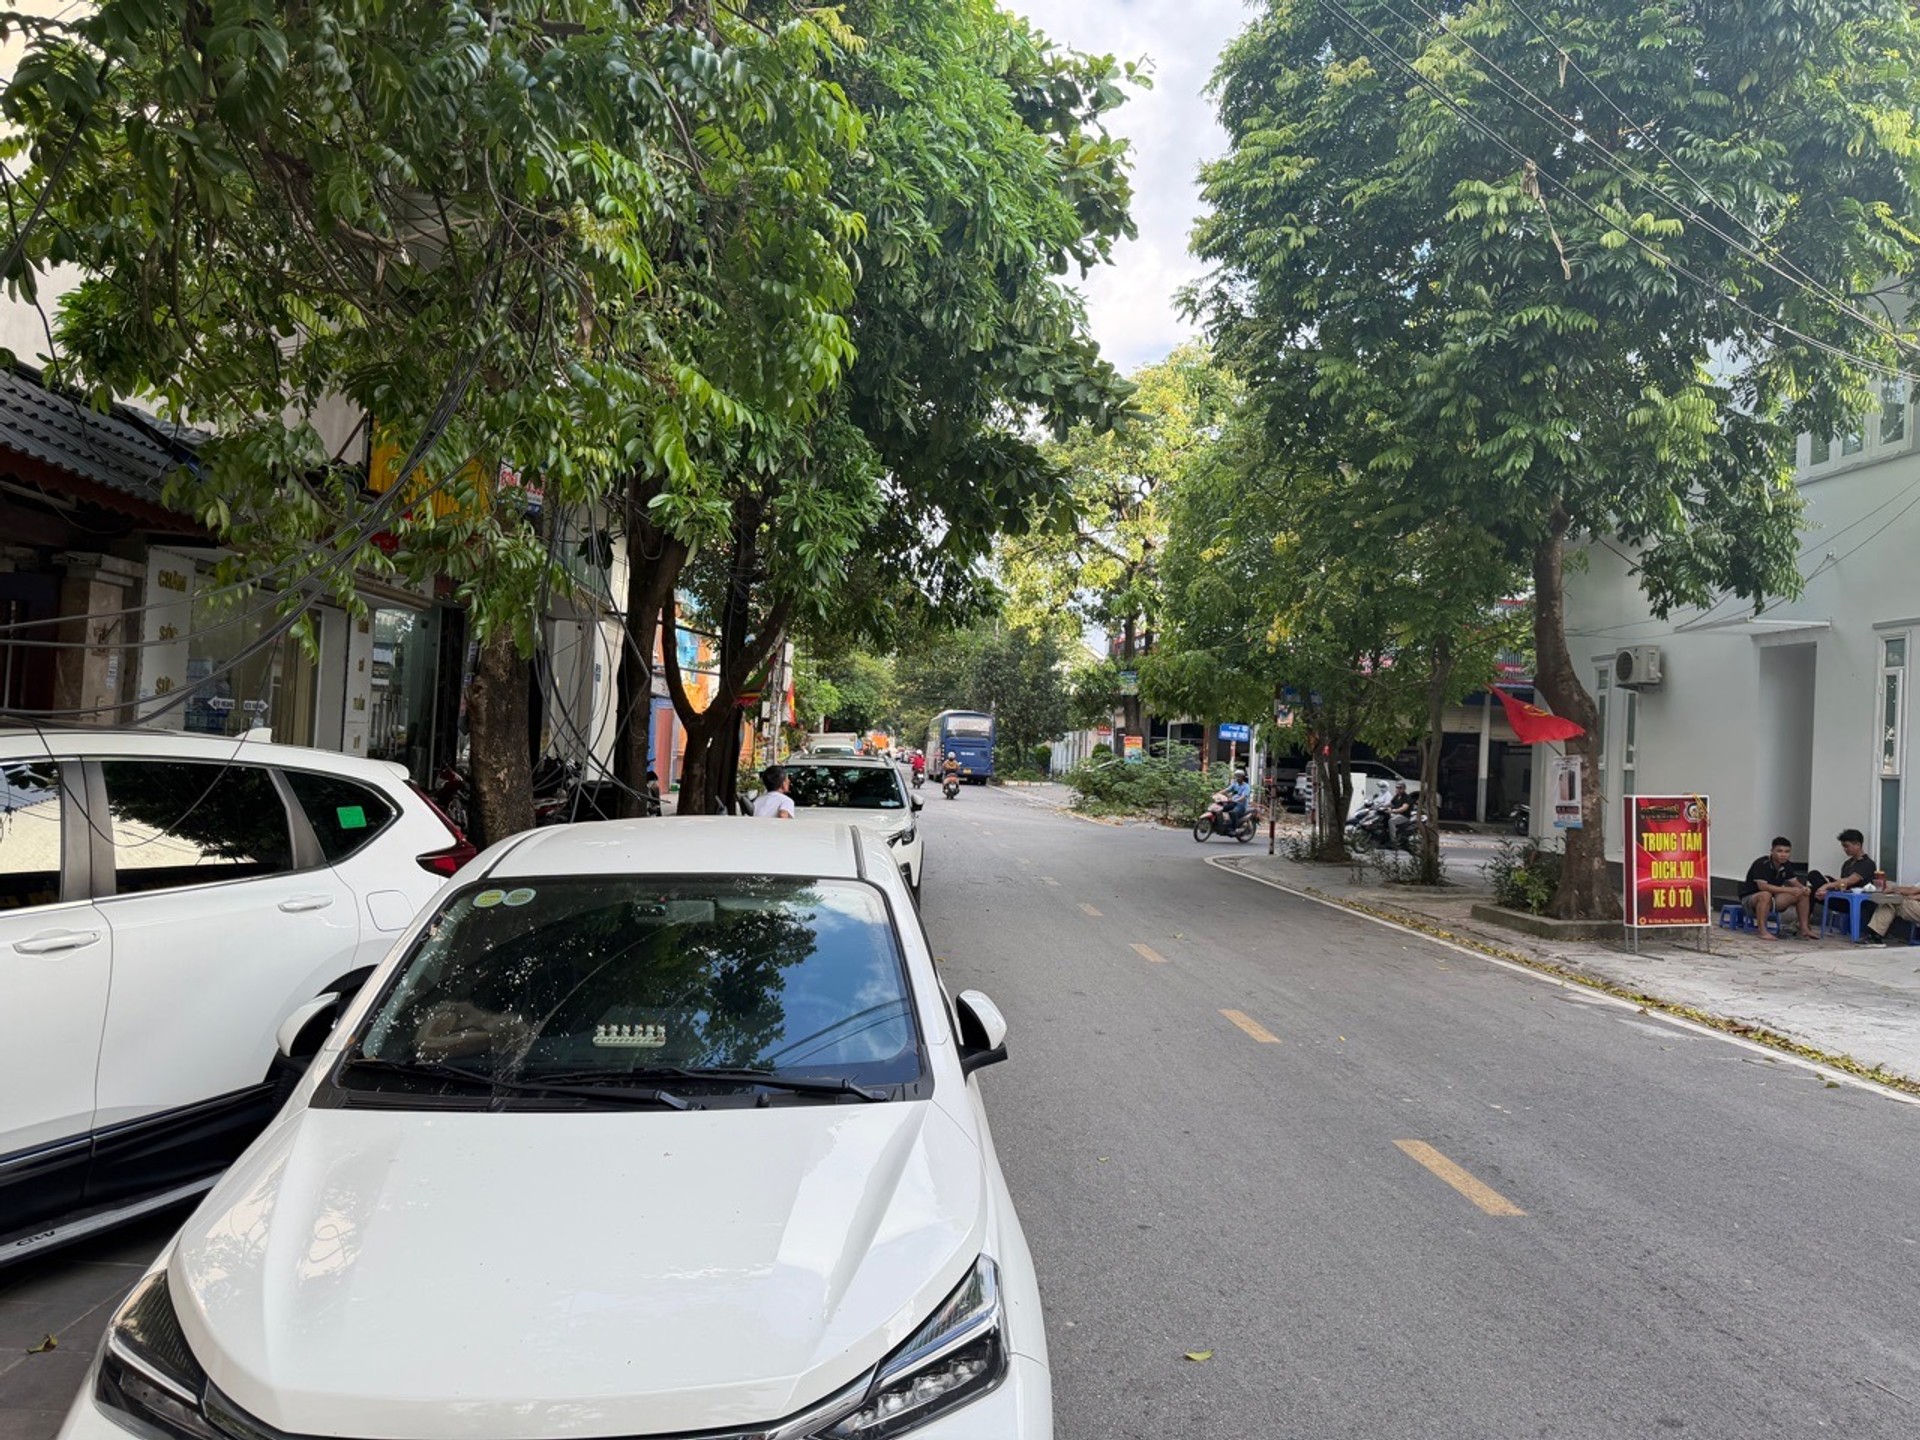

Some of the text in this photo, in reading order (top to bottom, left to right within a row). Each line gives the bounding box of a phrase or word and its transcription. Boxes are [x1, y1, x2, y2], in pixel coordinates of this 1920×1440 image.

[1641, 829, 1703, 852] TRUNG TÂM
[1653, 889, 1667, 908] XE
